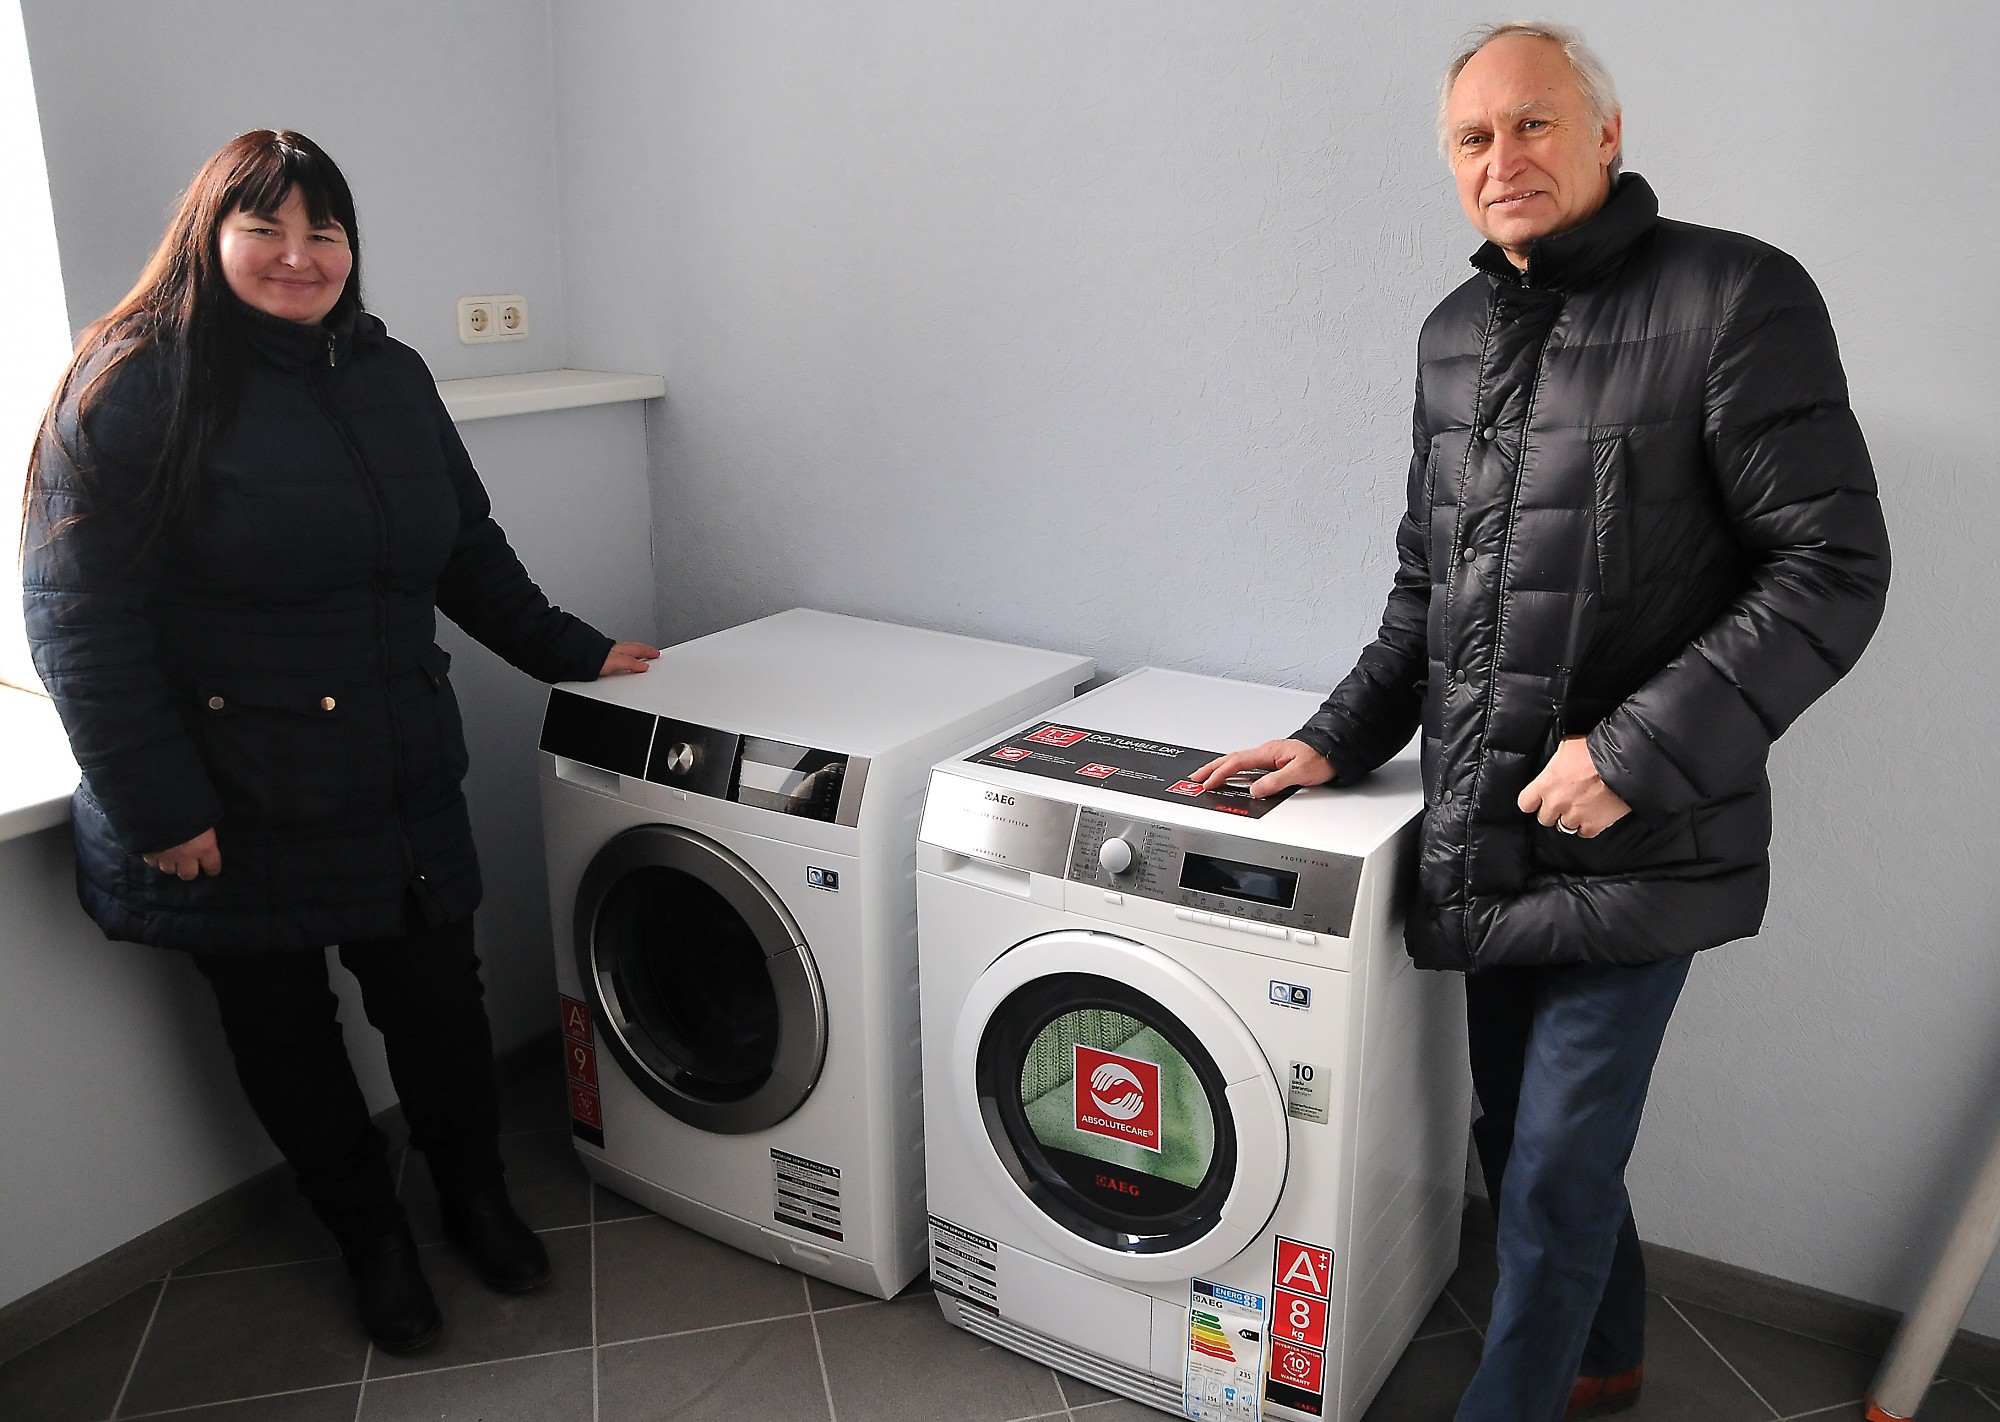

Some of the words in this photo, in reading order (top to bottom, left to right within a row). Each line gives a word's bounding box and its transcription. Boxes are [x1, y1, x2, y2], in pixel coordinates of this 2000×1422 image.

[1090, 734, 1111, 742] DO
[1113, 738, 1159, 751] TUMBLE
[1158, 746, 1185, 755] DRY
[991, 793, 1015, 806] AEG
[1008, 819, 1029, 828] SYSTEM
[574, 1047, 586, 1071] 9
[1291, 1063, 1315, 1082] 10
[771, 1151, 792, 1162] PREMIUM
[792, 1158, 809, 1167] SERVICE
[809, 1163, 832, 1175] PACKAGE
[1107, 1178, 1141, 1197] AEG
[929, 1217, 949, 1229] PREMIUM
[949, 1226, 967, 1238] SERVICE
[967, 1233, 988, 1247] PACKAGE
[1215, 1287, 1243, 1300] ENERG
[1201, 1296, 1224, 1309] AEG
[1289, 1299, 1310, 1329] 8
[1291, 1328, 1305, 1342] kg
[1289, 1357, 1305, 1370] 10
[1239, 1371, 1252, 1380] 235
[1280, 1373, 1311, 1387] WARRANTY
